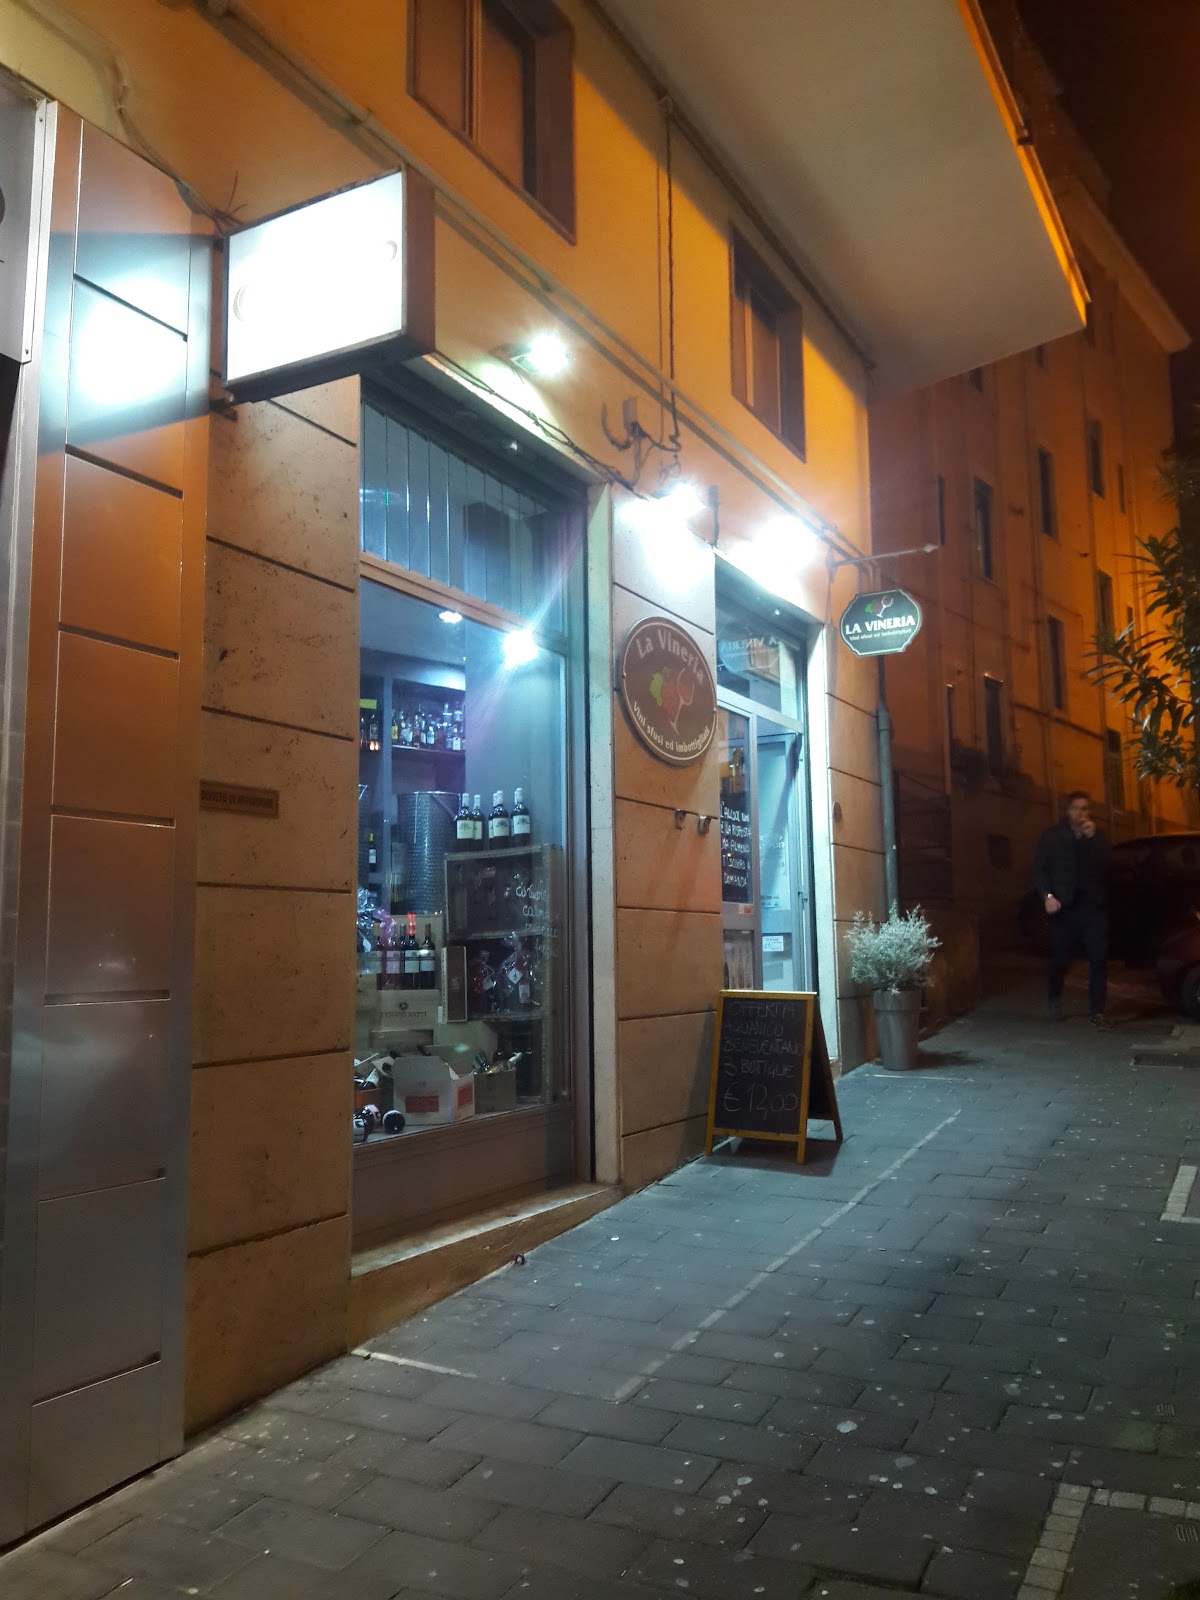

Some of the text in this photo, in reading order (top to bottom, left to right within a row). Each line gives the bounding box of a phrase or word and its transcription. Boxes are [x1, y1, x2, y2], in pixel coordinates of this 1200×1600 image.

[845, 615, 916, 635] LA VINERIA
[635, 629, 705, 686] La Vineria
[633, 700, 646, 727] Vini
[647, 724, 664, 746] sfusi
[665, 740, 675, 751] ed
[721, 837, 730, 851] MA
[730, 839, 750, 853] ALMENO
[729, 1000, 796, 1020] OFFERTA
[724, 1056, 737, 1077] 3
[723, 1082, 799, 1120] € 12,00
